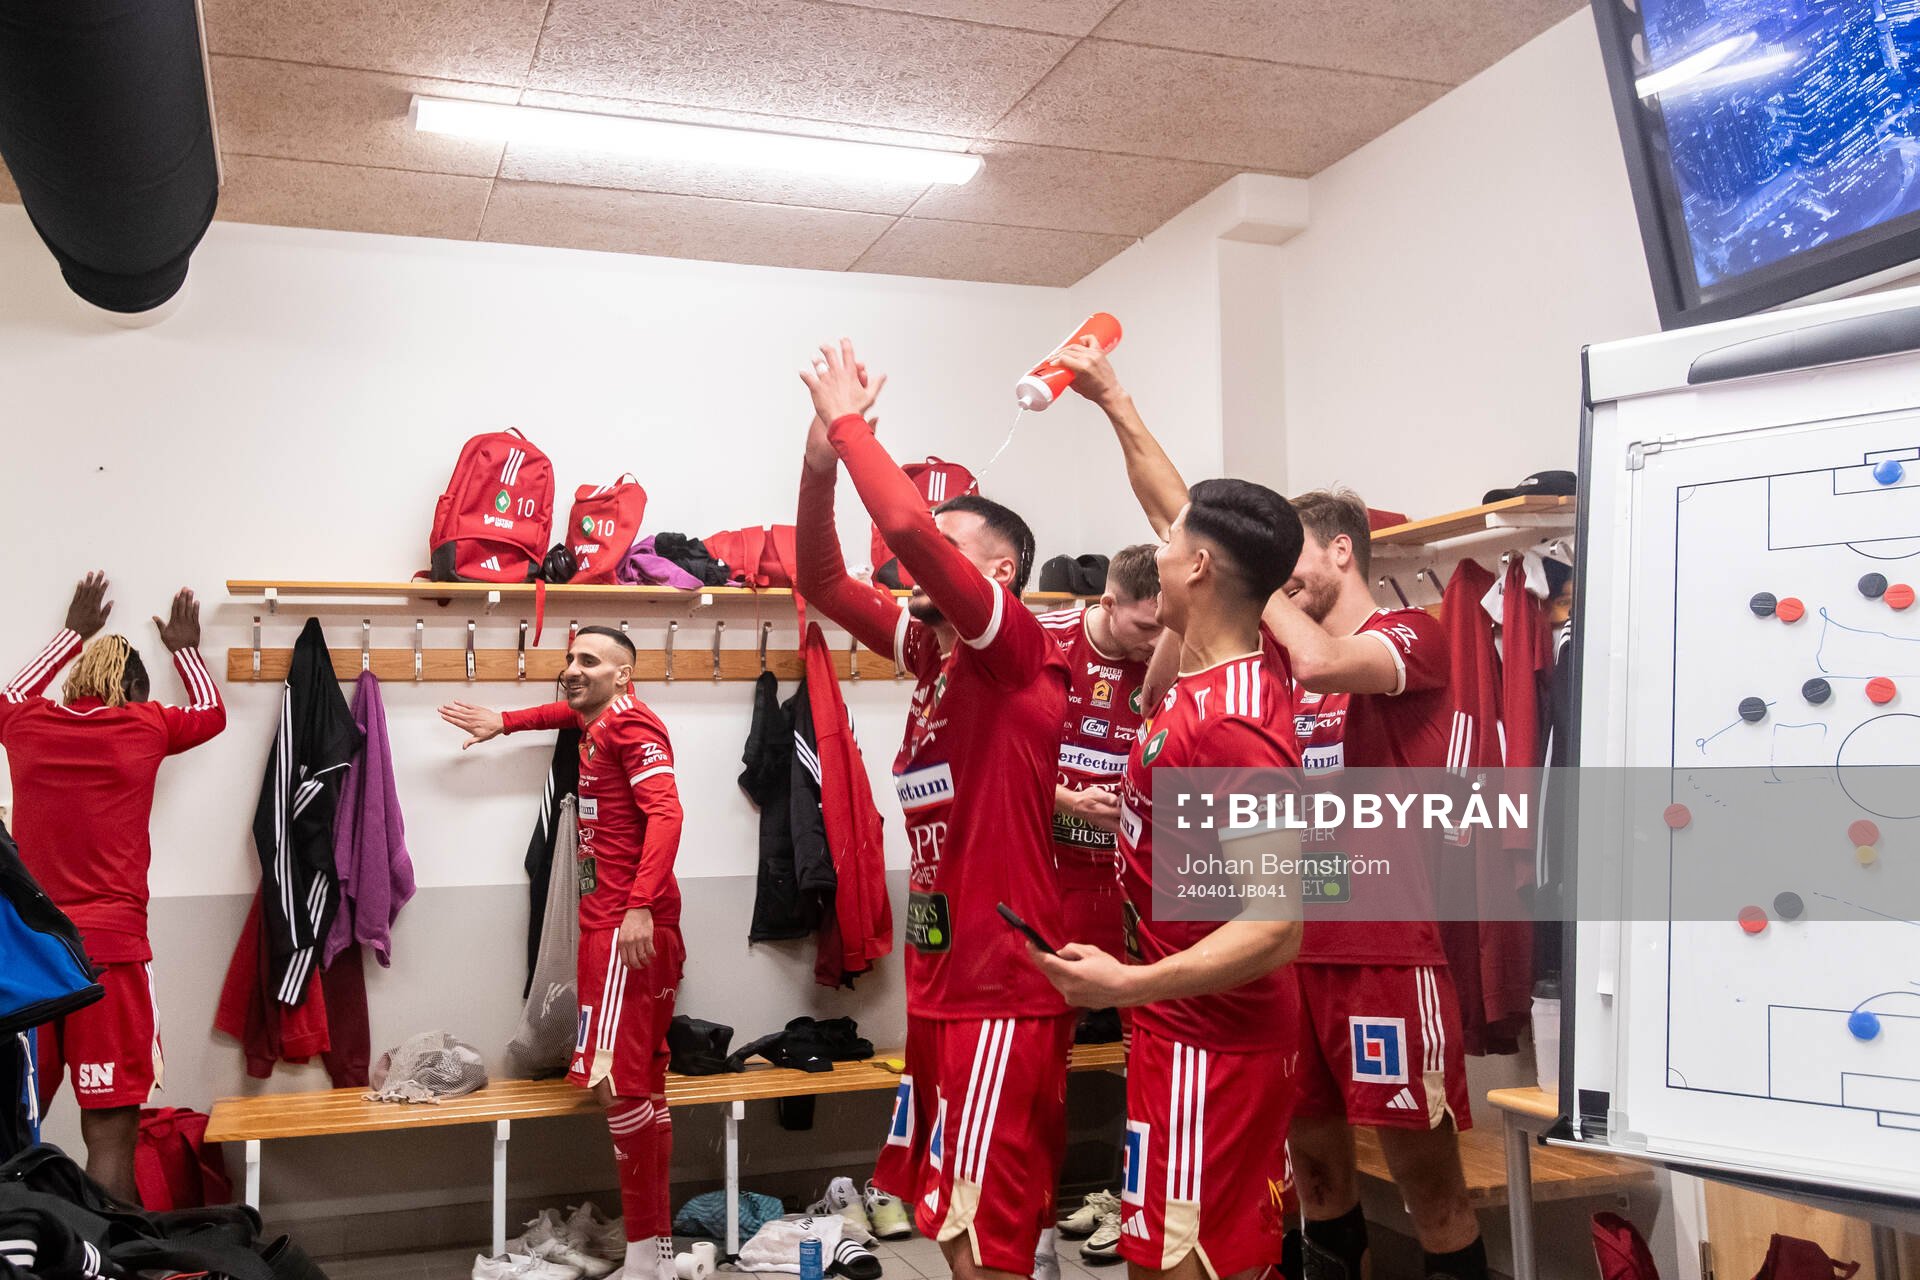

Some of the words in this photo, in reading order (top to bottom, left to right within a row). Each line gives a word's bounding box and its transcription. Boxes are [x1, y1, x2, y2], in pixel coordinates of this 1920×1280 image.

[517, 497, 535, 518] 10
[597, 519, 615, 537] 10
[1099, 672, 1121, 681] SPORT
[1100, 665, 1123, 675] INTER
[79, 1062, 115, 1088] SN
